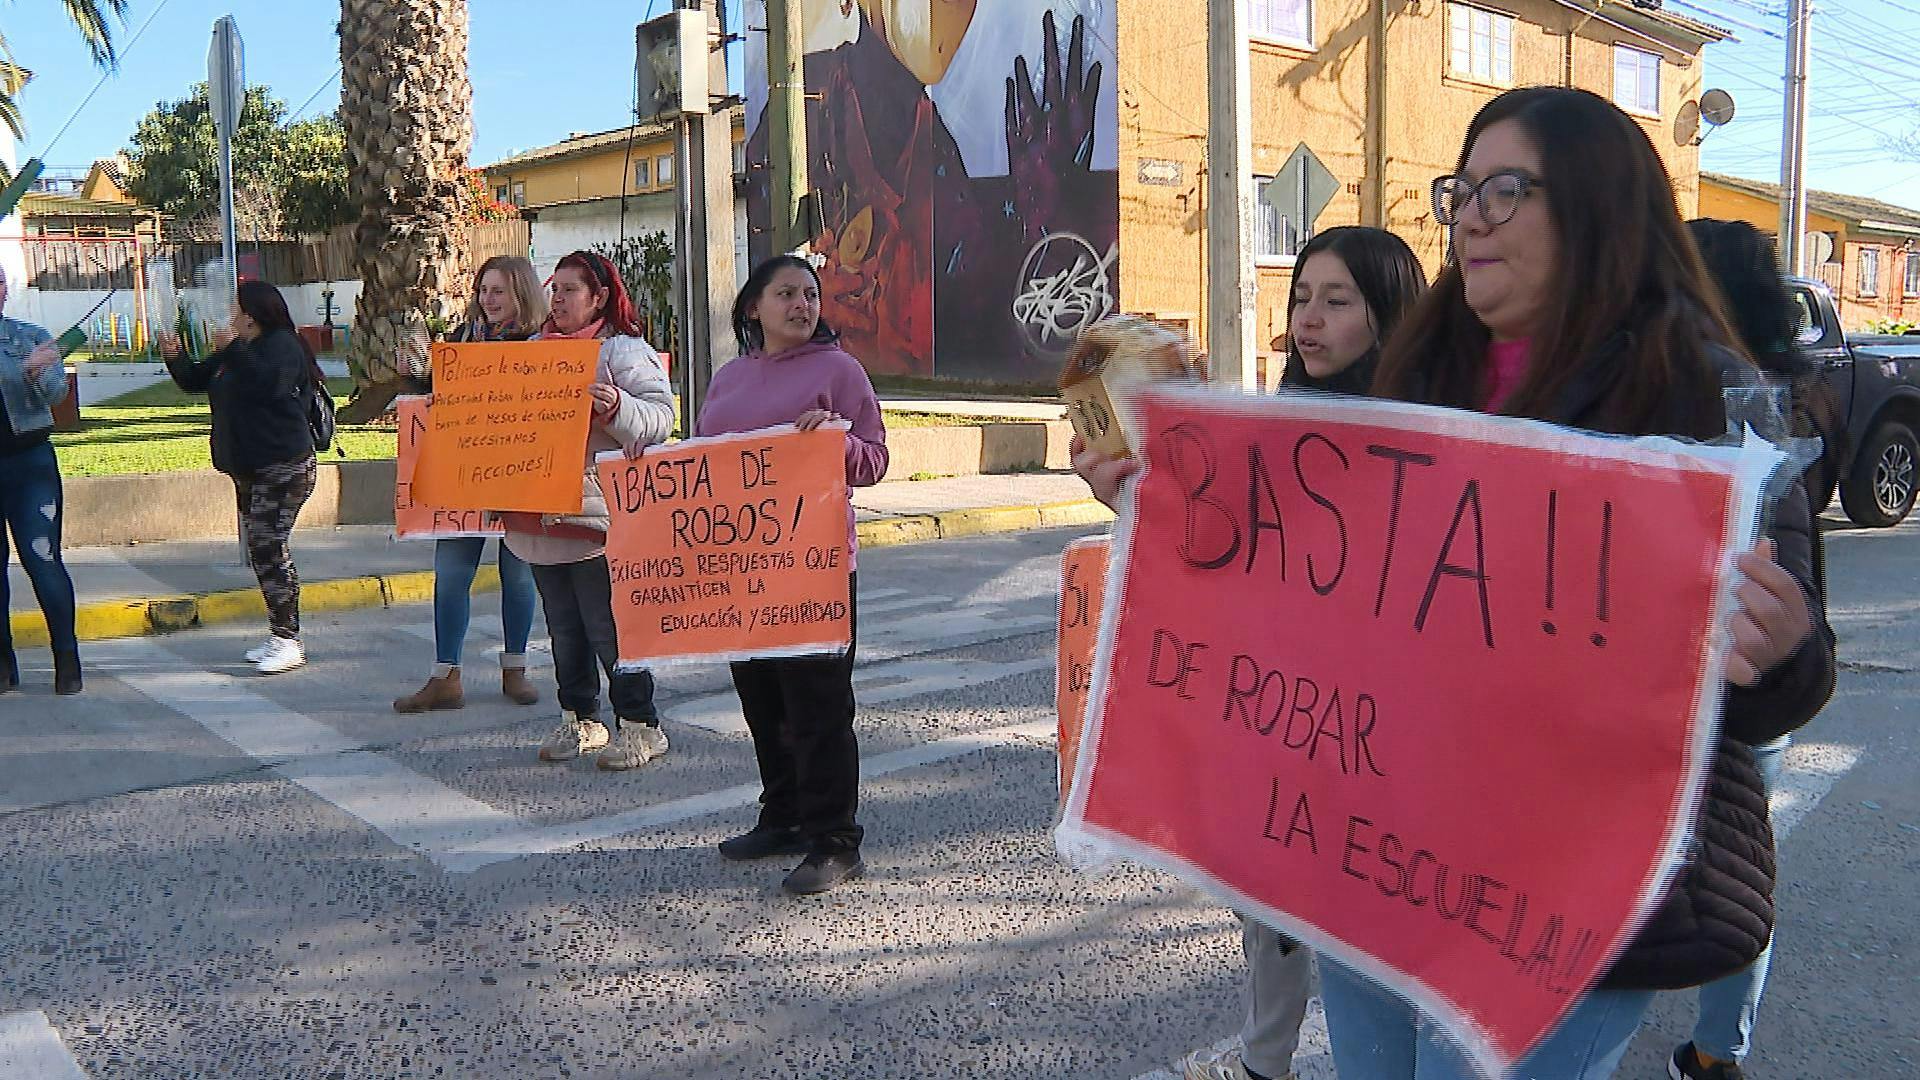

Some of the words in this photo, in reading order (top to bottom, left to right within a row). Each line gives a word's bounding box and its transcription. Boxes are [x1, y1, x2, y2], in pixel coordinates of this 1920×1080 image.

[741, 447, 777, 490] DE
[611, 557, 686, 584] EXIGIMOS
[697, 552, 795, 577] RESPUESTAS
[805, 546, 842, 570] QUE
[631, 580, 731, 606] GARANTICEN
[747, 578, 766, 594] LA
[661, 605, 743, 633] EDUCACIÓN
[1147, 627, 1209, 700] DE
[1222, 653, 1386, 777] ROBAR
[1263, 777, 1318, 856] LA
